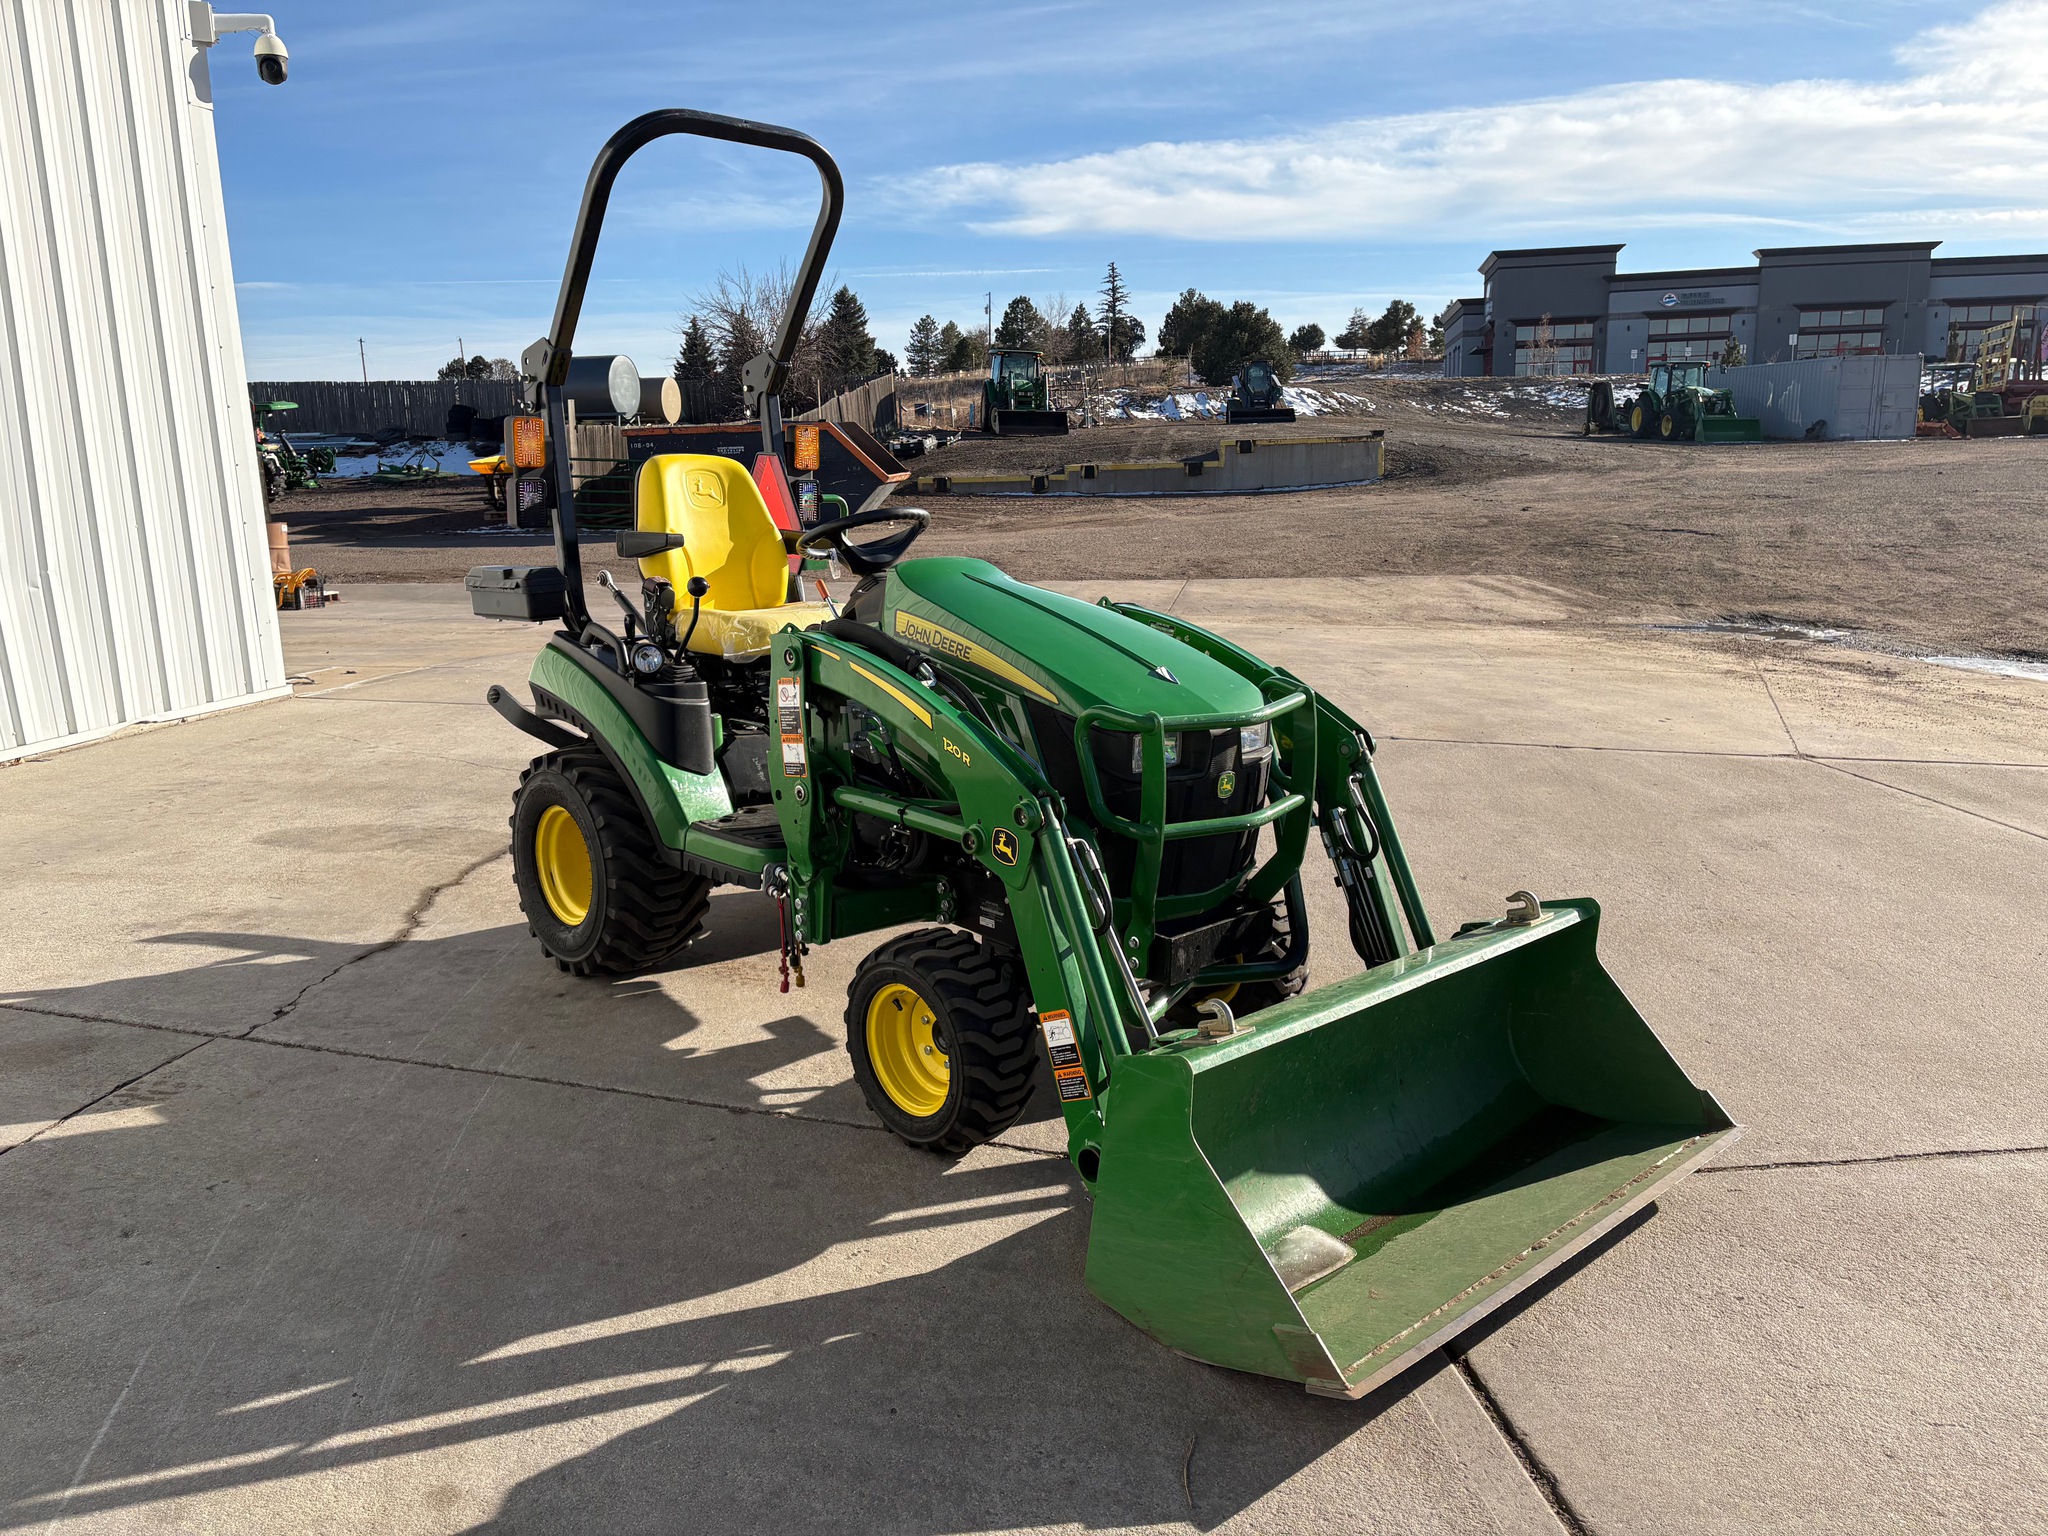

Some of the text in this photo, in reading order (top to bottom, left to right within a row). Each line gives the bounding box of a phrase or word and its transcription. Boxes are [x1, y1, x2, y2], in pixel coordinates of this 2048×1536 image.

[901, 620, 972, 660] JOHN DEERE
[943, 736, 971, 768] 120 R
[1048, 1012, 1066, 1020] WARNING
